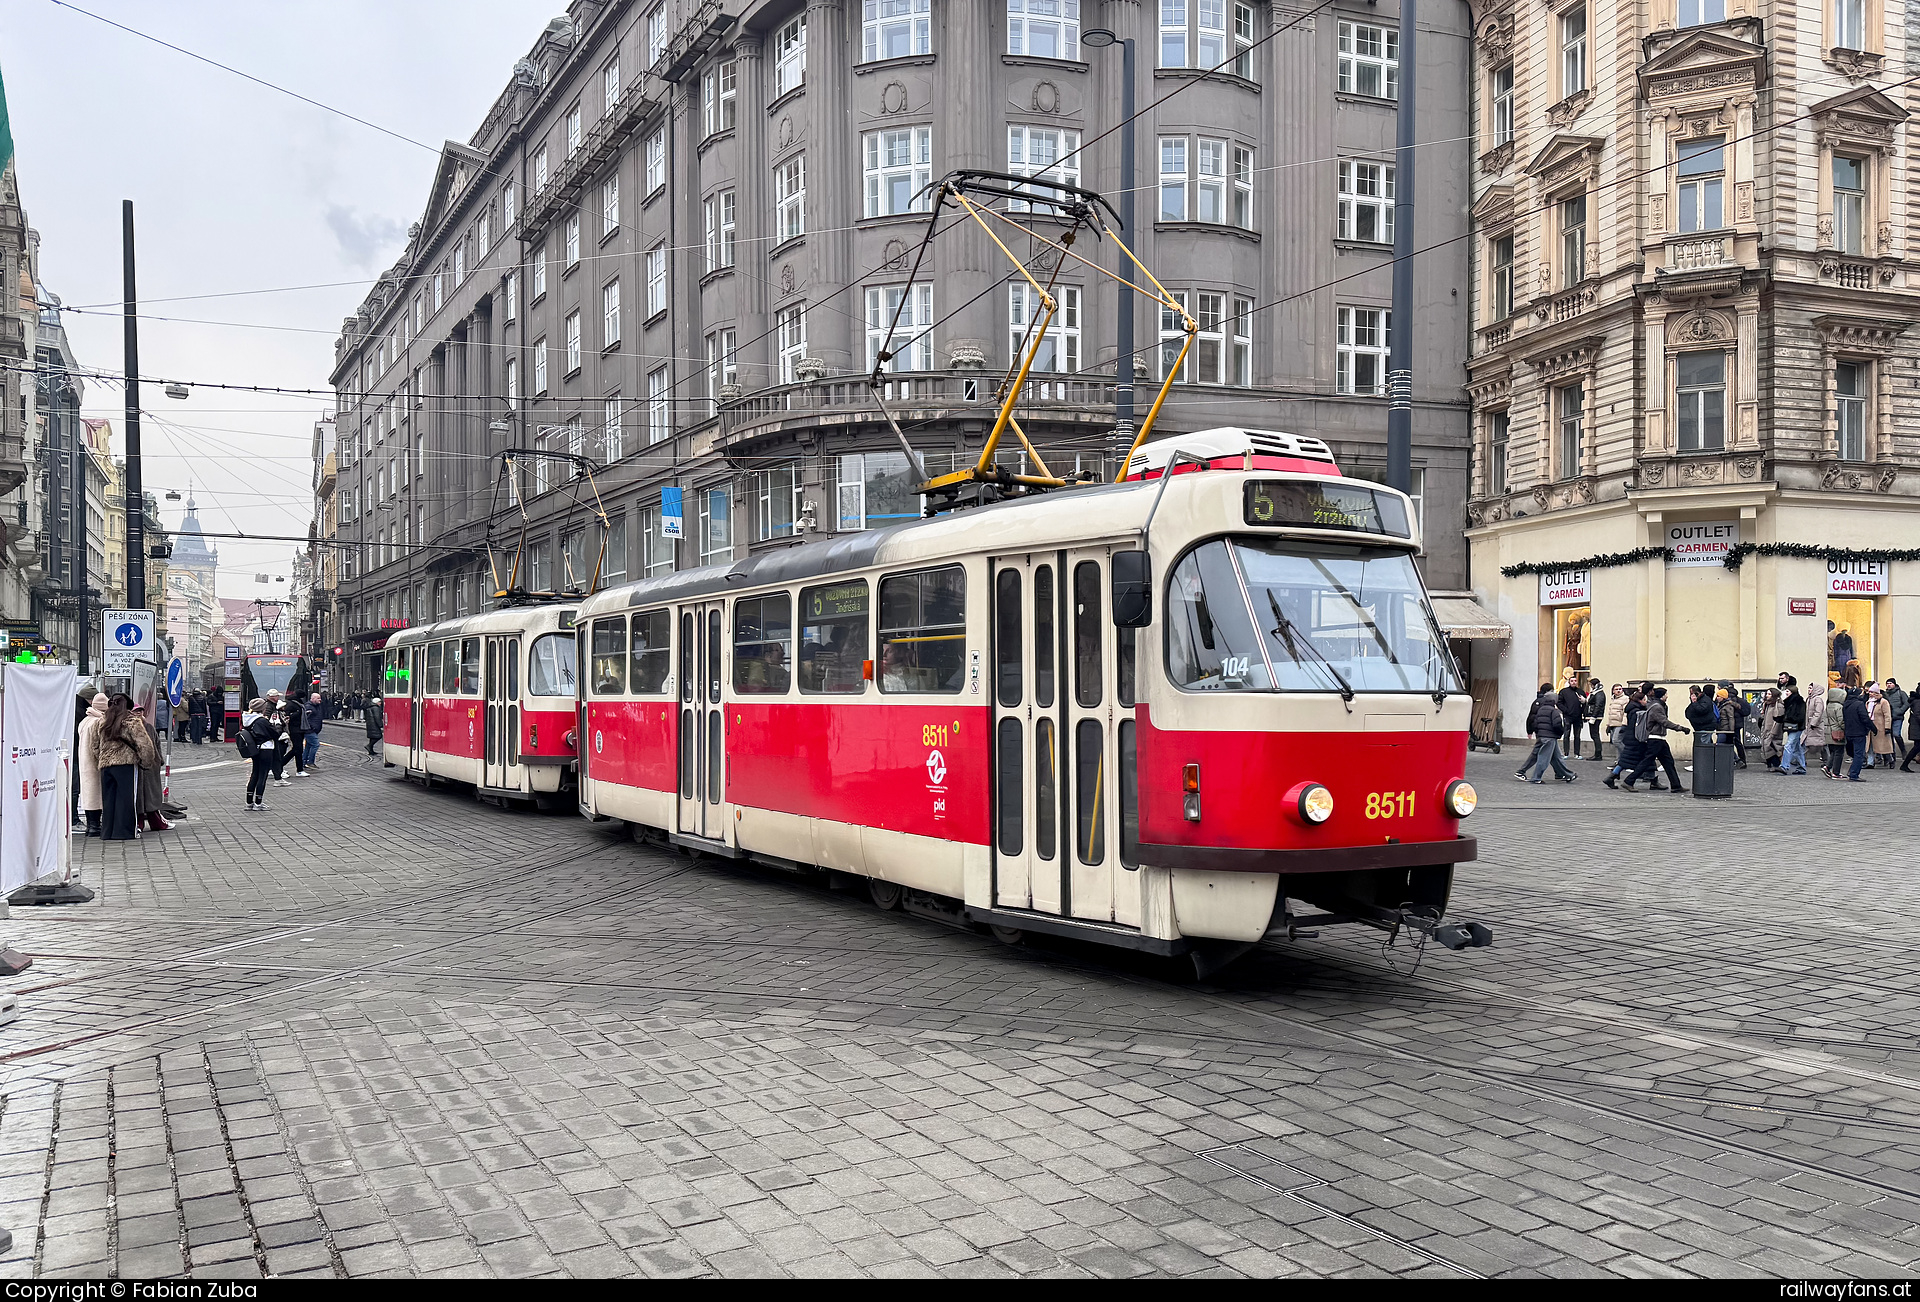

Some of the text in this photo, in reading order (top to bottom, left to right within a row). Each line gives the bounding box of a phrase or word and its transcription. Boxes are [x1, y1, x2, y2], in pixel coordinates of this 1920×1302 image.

[1254, 482, 1274, 521] 5
[1670, 525, 1734, 540] OUTLET
[1676, 542, 1729, 553] CARMEN
[1827, 560, 1886, 575] OUTLET
[1545, 570, 1588, 587] OUTLET
[1832, 579, 1881, 592] CARMEN
[1549, 587, 1584, 600] CARMEN
[814, 591, 823, 616] 5
[108, 612, 149, 620] PĚŠÍ ZÓNA
[381, 618, 410, 629] KINO
[1221, 656, 1249, 677] 104
[922, 724, 948, 747] 8511
[933, 797, 946, 814] pid
[1365, 790, 1416, 820] 8511
